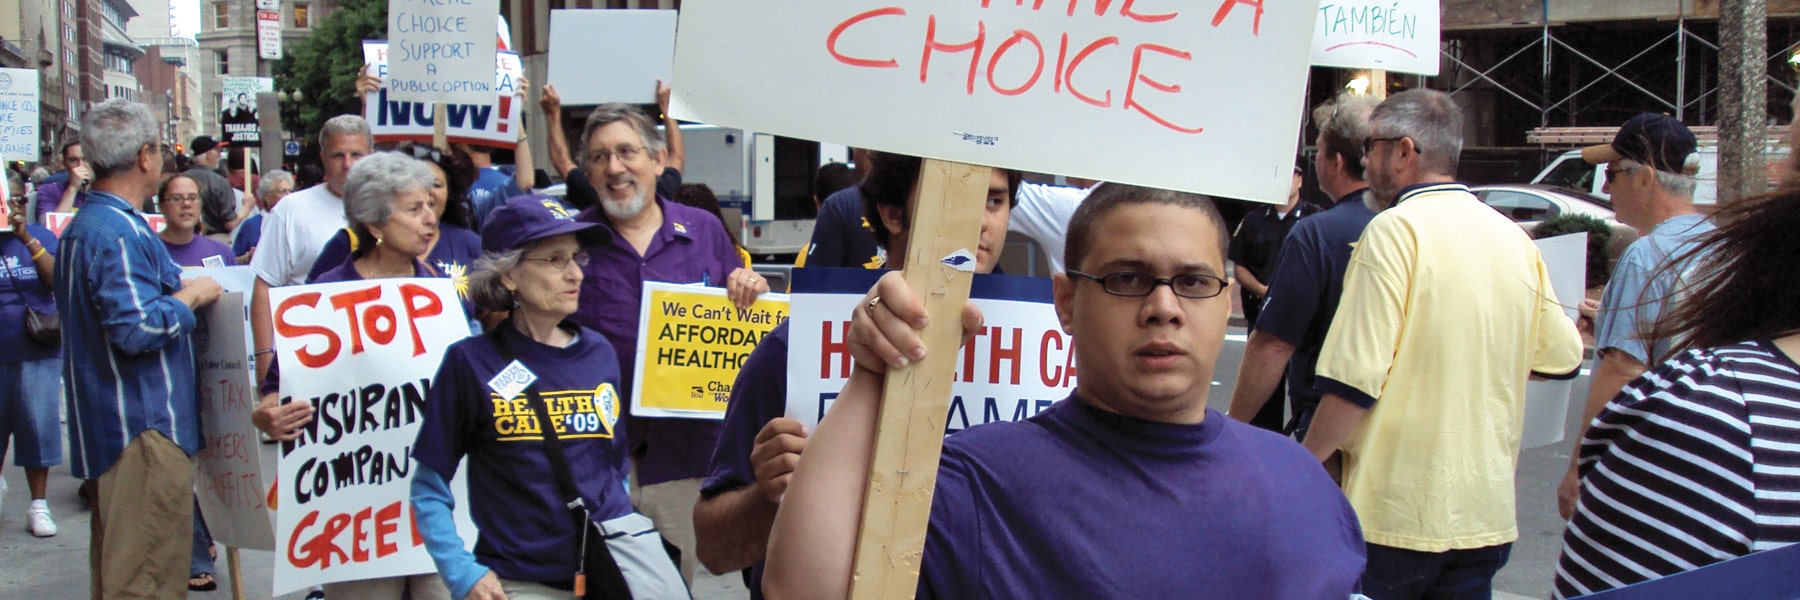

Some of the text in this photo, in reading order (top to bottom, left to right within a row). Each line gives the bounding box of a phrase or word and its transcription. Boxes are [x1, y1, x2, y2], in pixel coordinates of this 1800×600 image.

[397, 12, 467, 34] CHOICE
[1319, 1, 1417, 40] TAMBIÉN
[400, 39, 475, 61] SUPPORT
[426, 63, 437, 75] A
[826, 6, 1203, 134] CHOICE
[391, 79, 439, 92] PUBLIC
[442, 80, 490, 93] OPTION
[225, 123, 256, 133] TRABAJOS
[231, 132, 259, 142] JUSTICIA
[662, 301, 687, 317] We
[692, 304, 732, 321] Can't
[737, 308, 771, 324] Wait
[273, 283, 443, 368] STOP
[219, 379, 247, 411] TAX
[491, 395, 595, 417] HELTH
